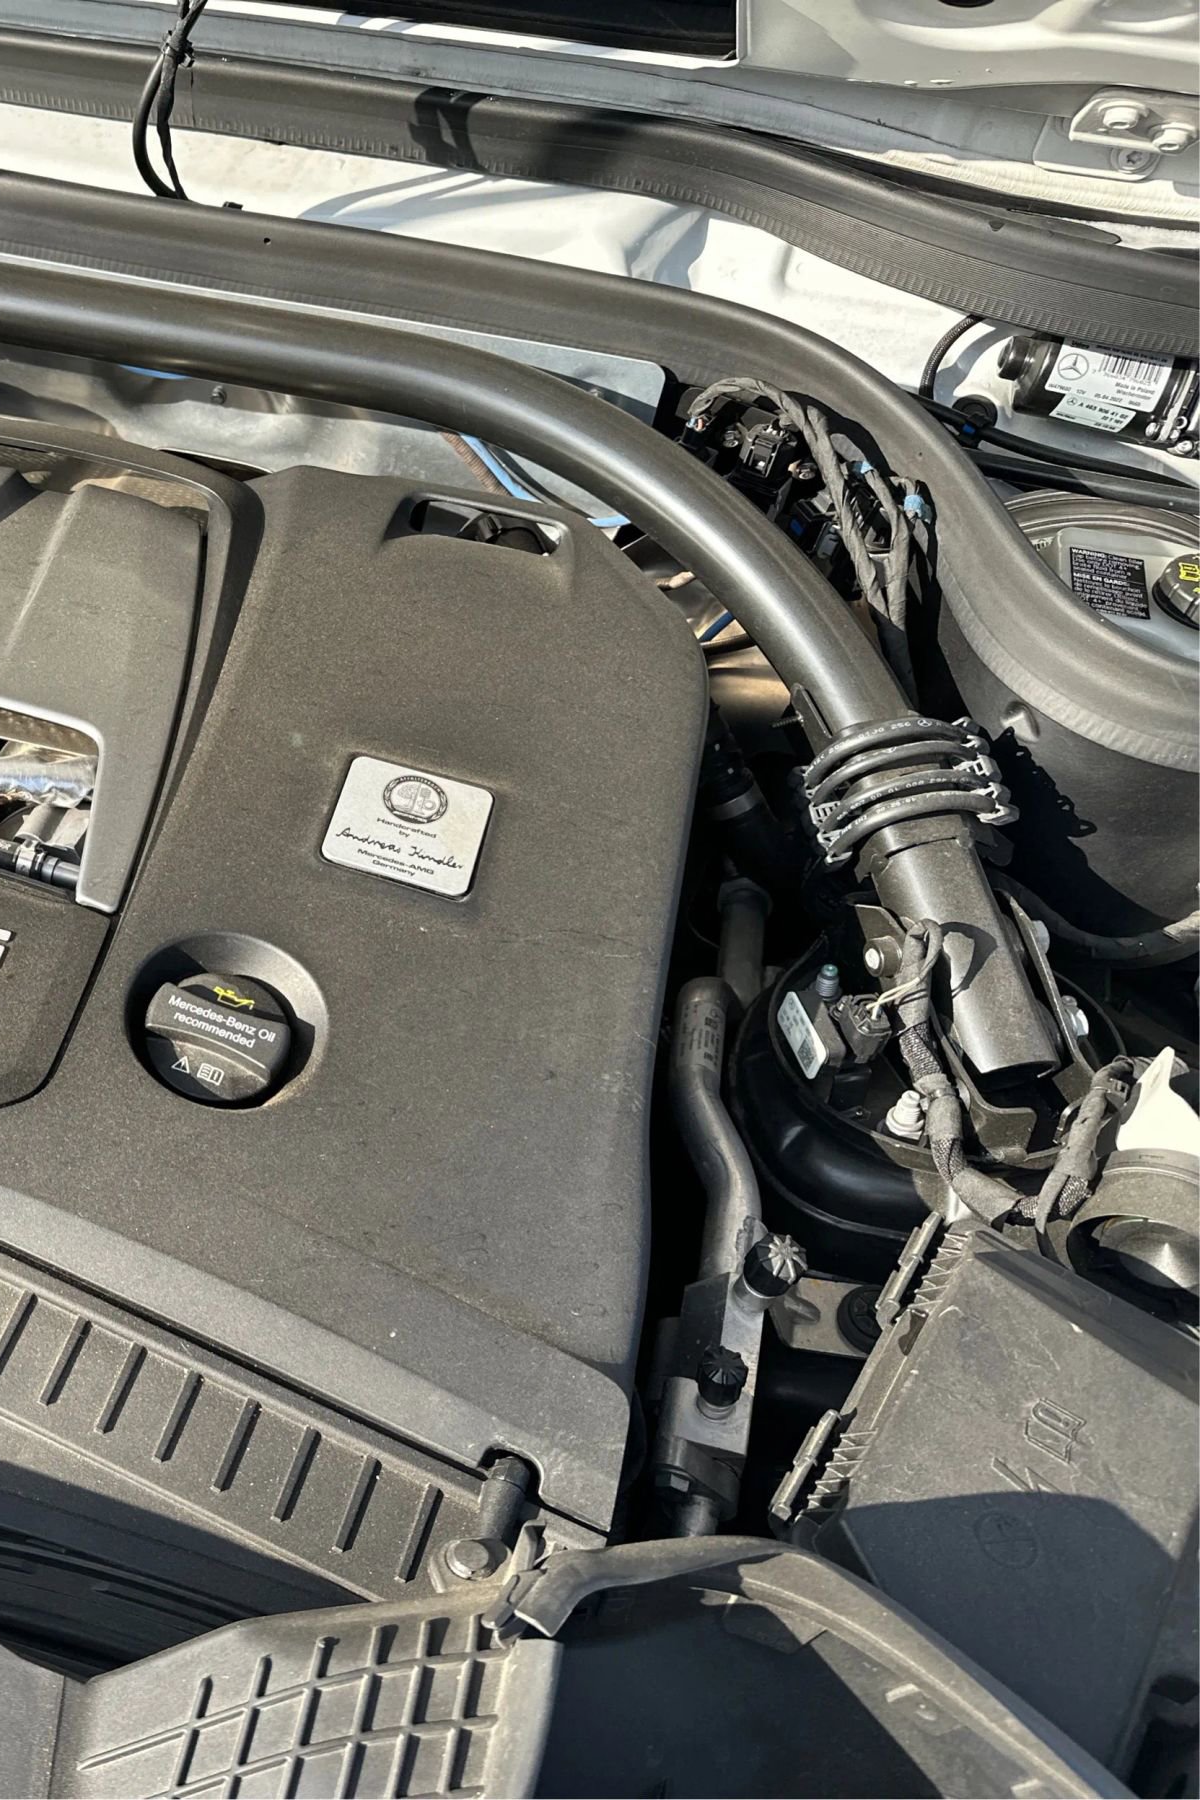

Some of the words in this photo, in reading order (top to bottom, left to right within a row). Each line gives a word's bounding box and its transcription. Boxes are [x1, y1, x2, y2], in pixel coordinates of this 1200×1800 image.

[1071, 548, 1107, 558] WARNING:
[376, 817, 437, 838] Handcrafted
[398, 830, 410, 838] by
[357, 848, 434, 875] Mercedes-AMG
[372, 859, 416, 877] Germany
[168, 995, 257, 1036] Mercedes-Benz
[258, 1028, 276, 1043] Oil
[174, 1010, 256, 1049] recommended
